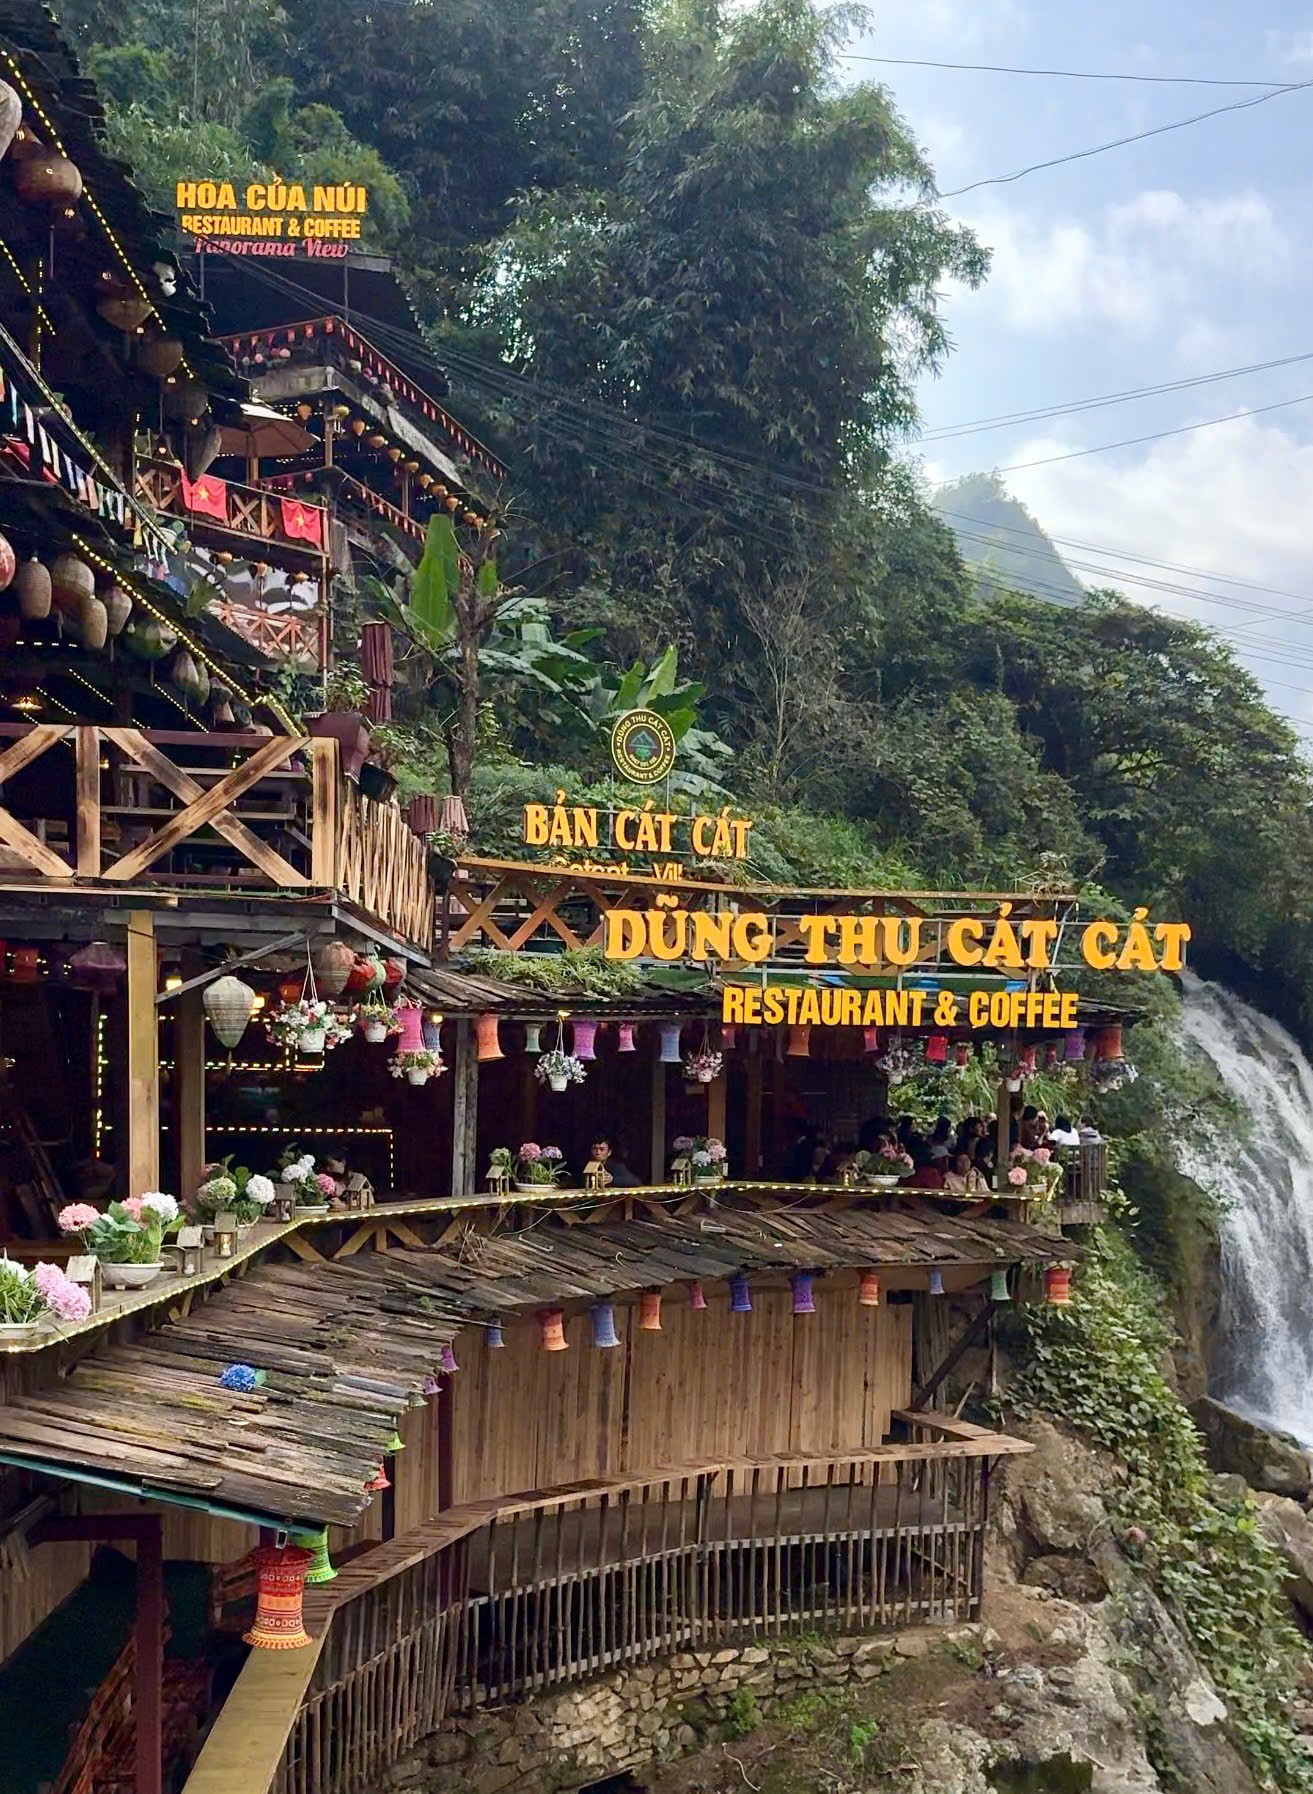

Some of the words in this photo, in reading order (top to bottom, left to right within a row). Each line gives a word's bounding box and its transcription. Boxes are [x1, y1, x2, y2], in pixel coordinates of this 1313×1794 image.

[177, 181, 237, 209] HOA
[246, 175, 307, 211] CỦA
[313, 181, 367, 213] NÚI
[182, 214, 284, 237] RESTAURANT
[288, 218, 300, 237] &
[304, 218, 361, 239] COFFEE
[302, 238, 349, 258] View
[524, 789, 598, 847] BẢN
[615, 800, 677, 853] CÁT
[692, 806, 753, 859] CÁT
[604, 892, 774, 962] DŨNG
[800, 914, 923, 966] THU
[947, 902, 1058, 969] CÁT
[1081, 907, 1192, 971] CÁT
[722, 987, 926, 1027] RESTAURANT
[934, 991, 957, 1027] &
[970, 992, 1079, 1029] COFFEE
